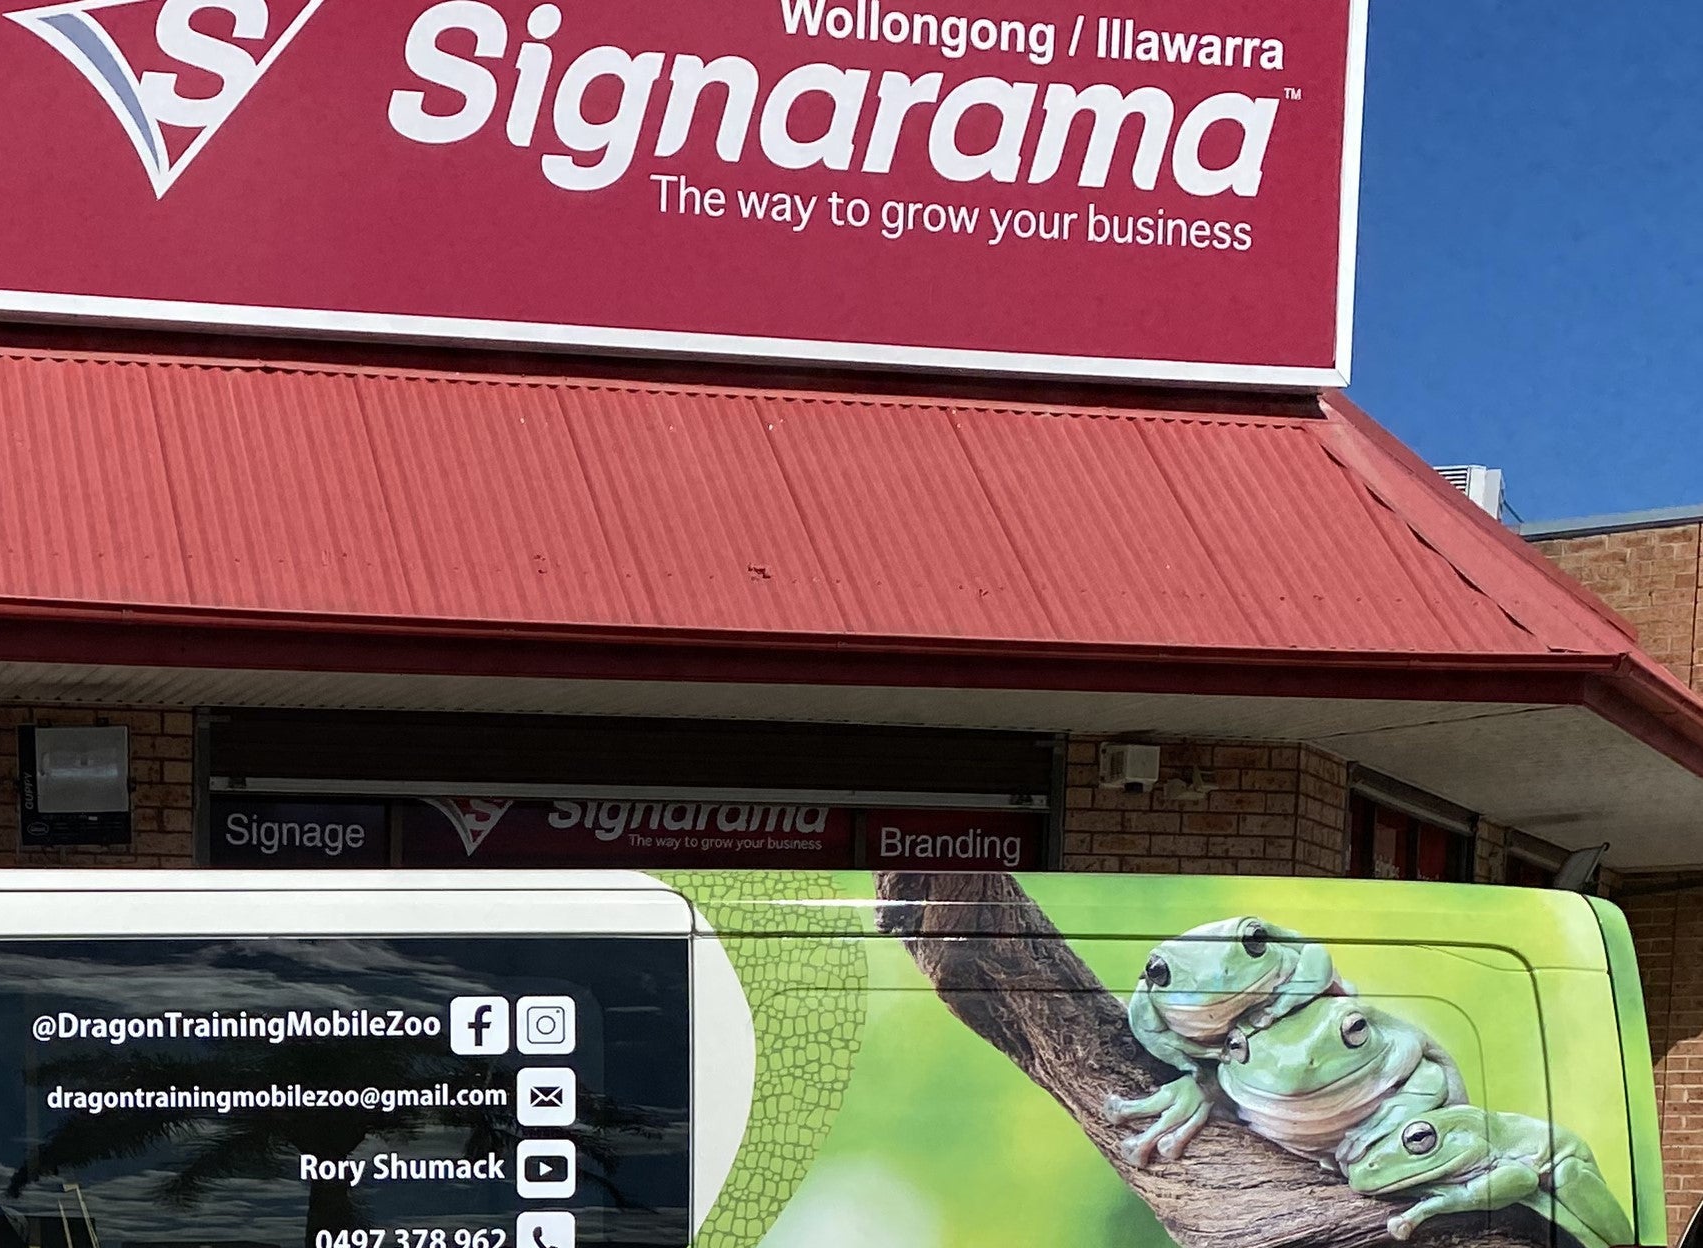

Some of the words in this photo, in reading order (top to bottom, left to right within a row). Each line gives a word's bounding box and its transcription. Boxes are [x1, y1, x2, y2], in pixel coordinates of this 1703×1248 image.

[781, 0, 1056, 65] Wollongong
[1068, 15, 1086, 55] /
[1098, 17, 1285, 71] Illawarra
[387, 0, 1281, 197] Signarama
[649, 173, 725, 216] The
[737, 189, 818, 232] way
[828, 191, 870, 227] to
[881, 200, 979, 239] grow
[989, 208, 1079, 245] your
[1087, 204, 1253, 251] business
[225, 813, 366, 857] Signage
[628, 833, 653, 848] The
[655, 837, 681, 852] way
[684, 835, 699, 849] to
[701, 837, 734, 852] grow
[735, 838, 766, 852] your
[767, 836, 823, 851] business
[879, 826, 1022, 867] Branding
[32, 1009, 441, 1045] @DragonTrainingMobileZoo
[47, 1083, 507, 1114] dragontrainingmobilezoo@gmail.com
[300, 1153, 366, 1187] Rory
[373, 1152, 506, 1180] Shumack
